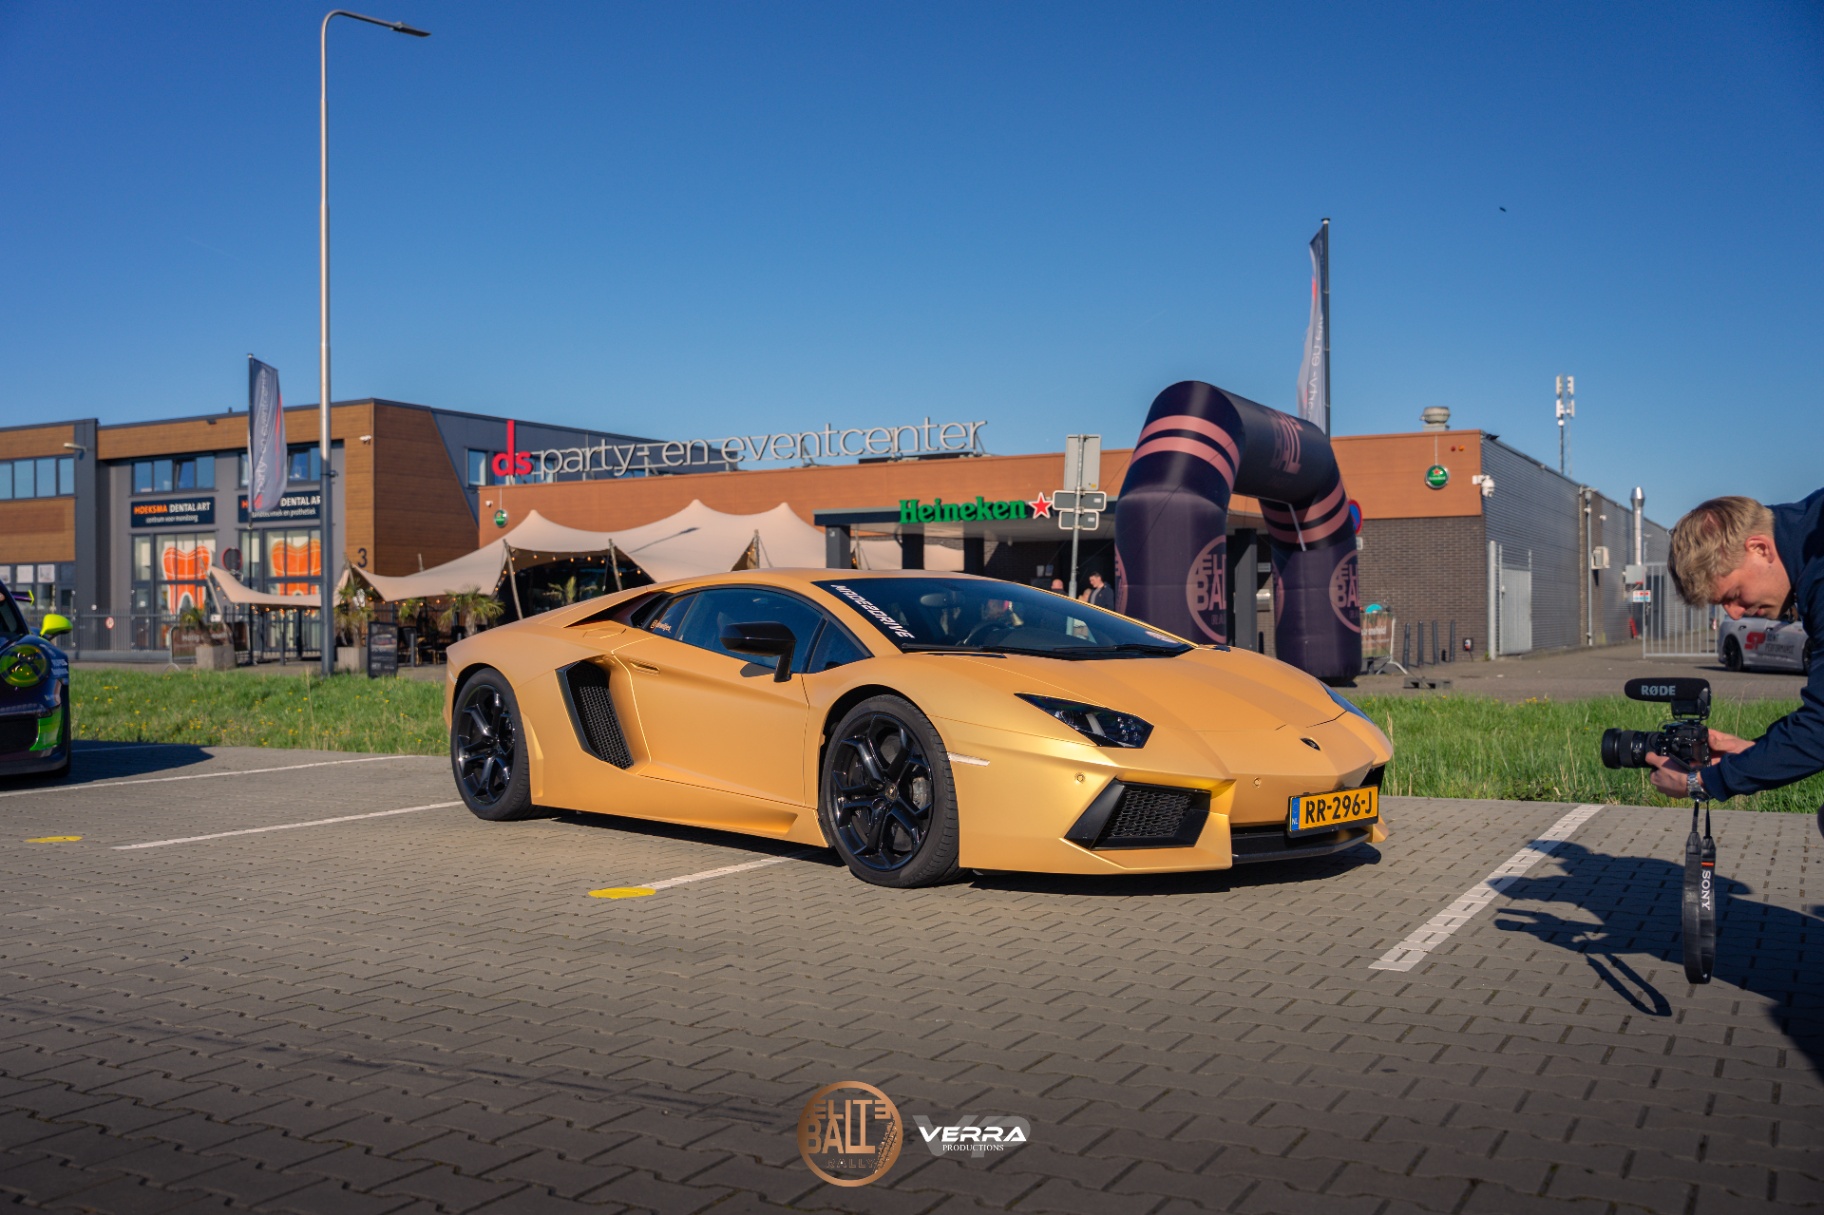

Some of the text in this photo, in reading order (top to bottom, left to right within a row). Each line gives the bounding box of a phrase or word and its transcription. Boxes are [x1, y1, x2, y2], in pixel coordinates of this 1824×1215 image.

[491, 416, 987, 480] ds party- en eventcenter
[134, 502, 211, 514] HOEKSMA DENTAL ART
[280, 495, 320, 507] DENTAL AR
[899, 496, 1027, 524] Heineken
[357, 547, 368, 568] 3
[1641, 685, 1676, 696] RØDE
[1305, 791, 1372, 824] RR-296-J
[1292, 817, 1299, 825] NL
[1701, 870, 1711, 911] SONY
